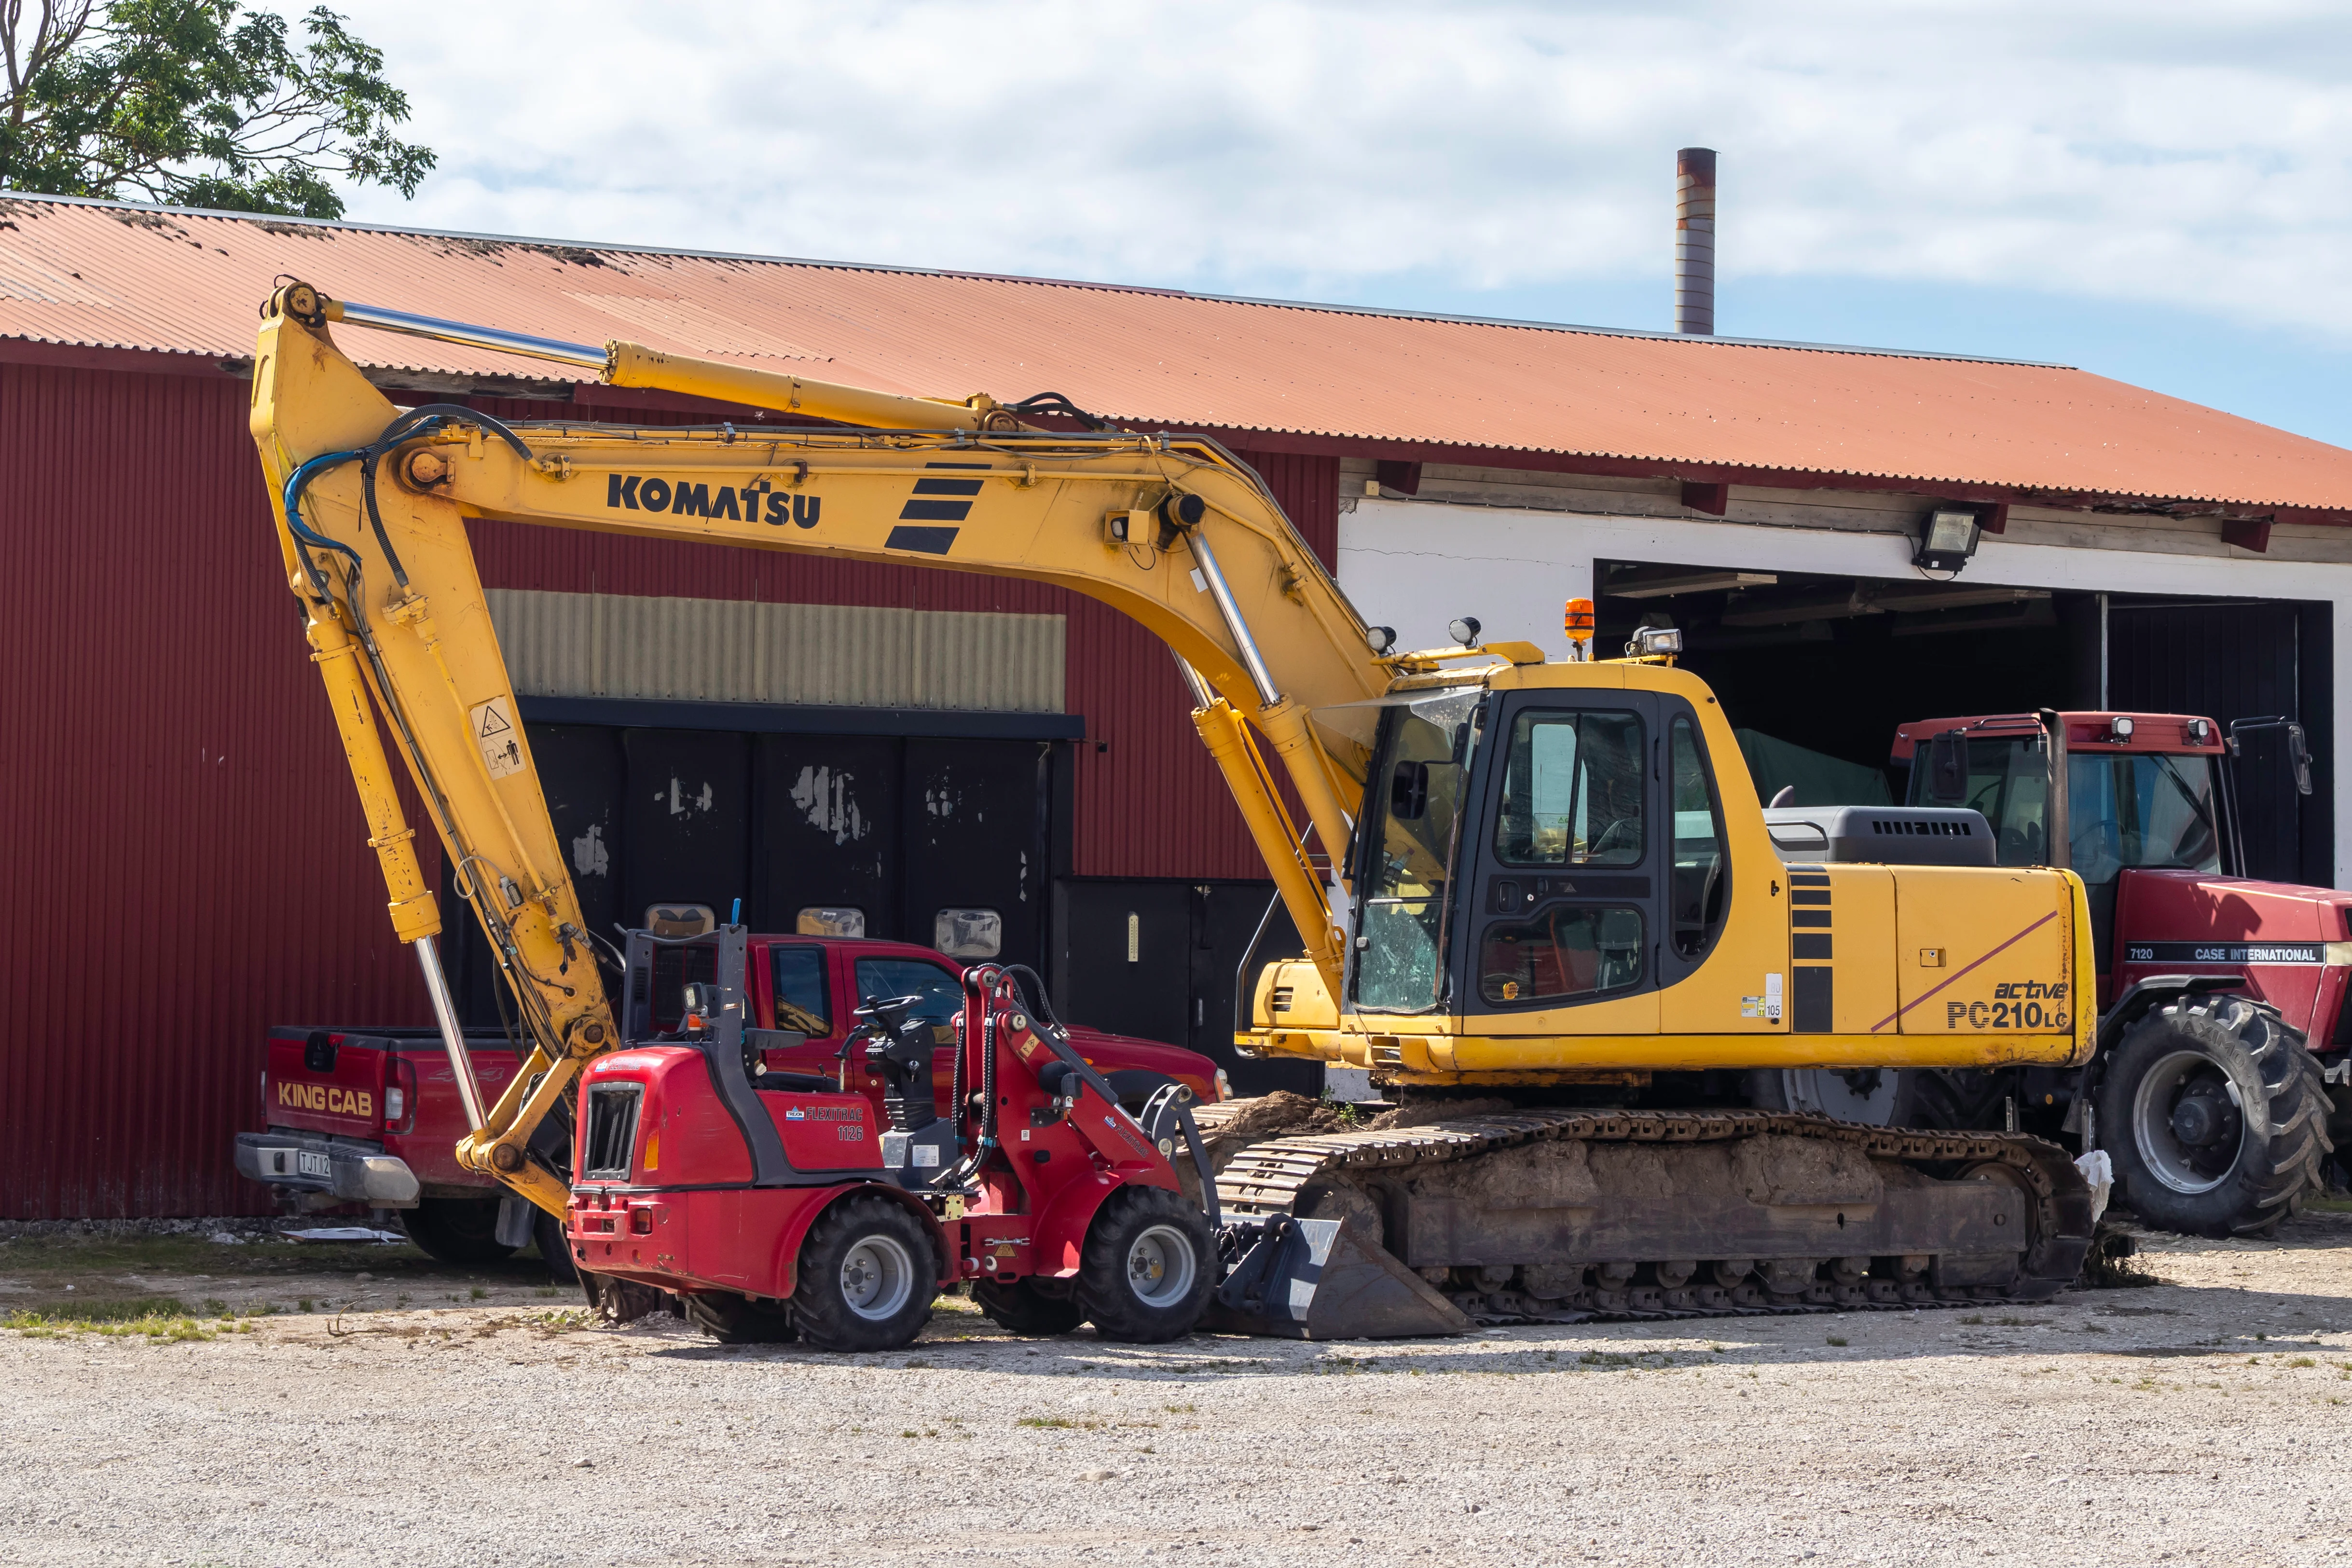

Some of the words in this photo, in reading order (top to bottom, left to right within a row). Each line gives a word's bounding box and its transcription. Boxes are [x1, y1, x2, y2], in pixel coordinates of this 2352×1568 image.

[607, 473, 821, 529] KOMATSU
[2130, 948, 2153, 960] 7120
[2195, 949, 2226, 960] CASE
[2230, 949, 2316, 961] INTERNATIONAL
[1767, 1005, 1780, 1016] 105
[278, 1082, 326, 1110] KING
[329, 1088, 372, 1117] CAB
[806, 1106, 863, 1122] FLEXITRAC
[838, 1126, 863, 1142] 1126
[1114, 1123, 1149, 1158] FLEXITRAC
[301, 1154, 317, 1172] TJT
